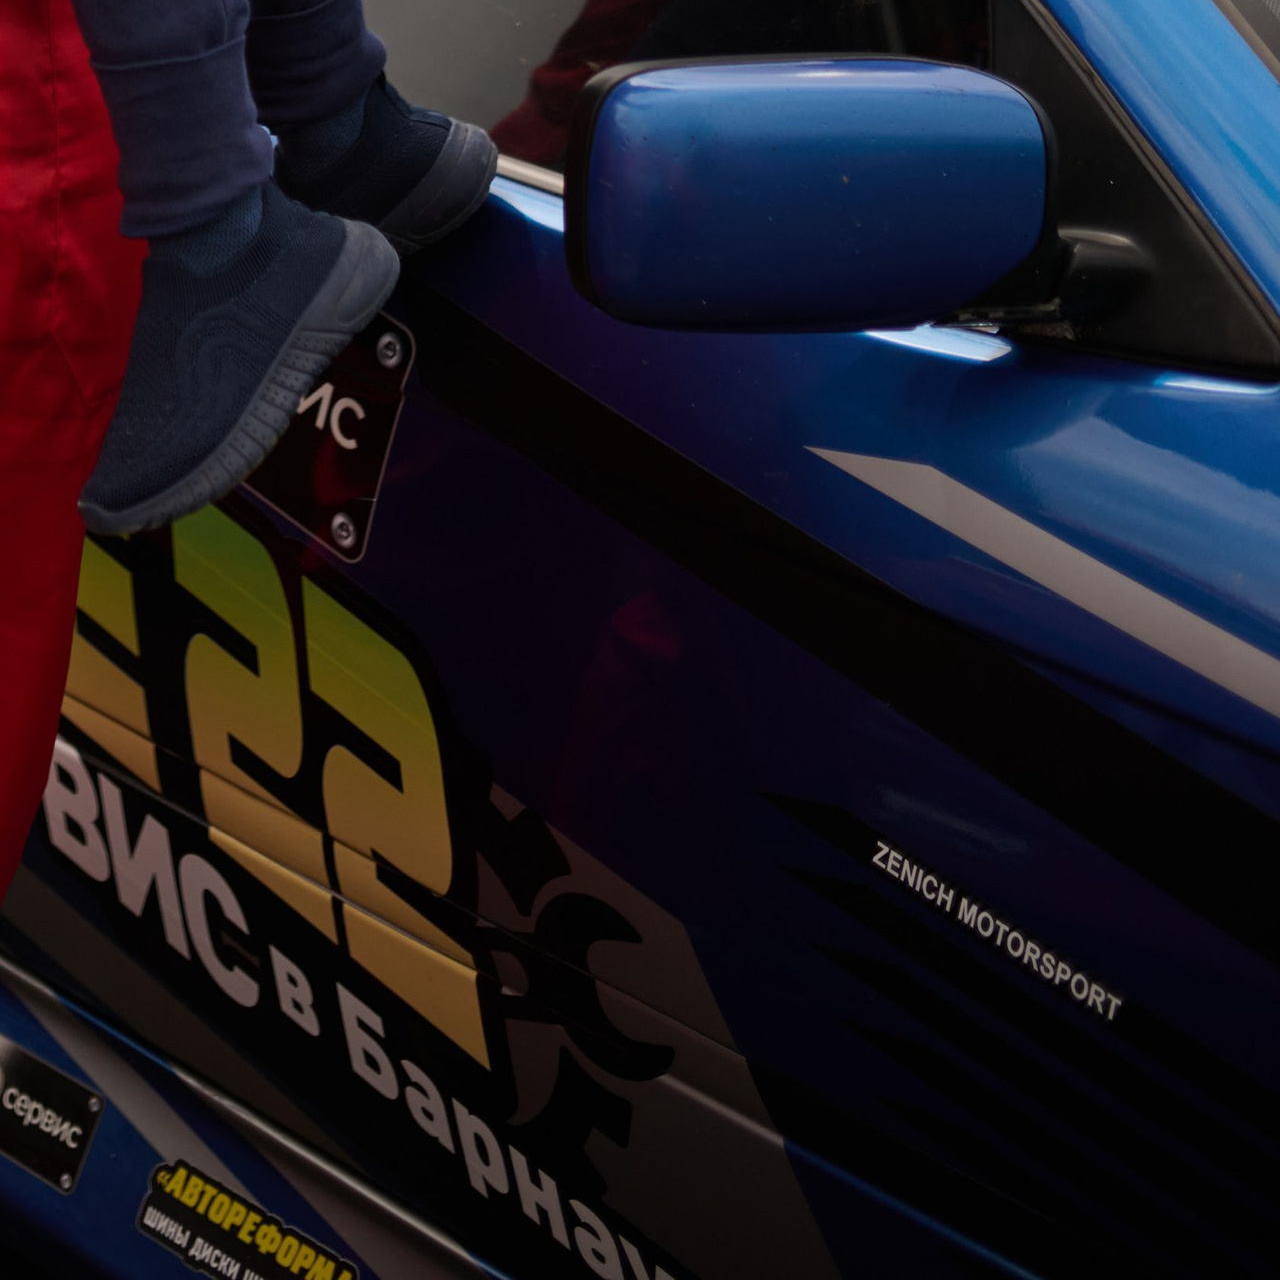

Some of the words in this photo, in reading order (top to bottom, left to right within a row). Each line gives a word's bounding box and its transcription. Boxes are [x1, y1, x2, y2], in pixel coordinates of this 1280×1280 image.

[871, 840, 955, 913] ZENICH
[957, 896, 1122, 1022] MOTORSPORT
[1, 1086, 83, 1149] сервис
[142, 1205, 192, 1249] ШИНЫ
[188, 1236, 241, 1280] ДИСКИ
[155, 1165, 355, 1280] «АВТОРЕФОРМ
